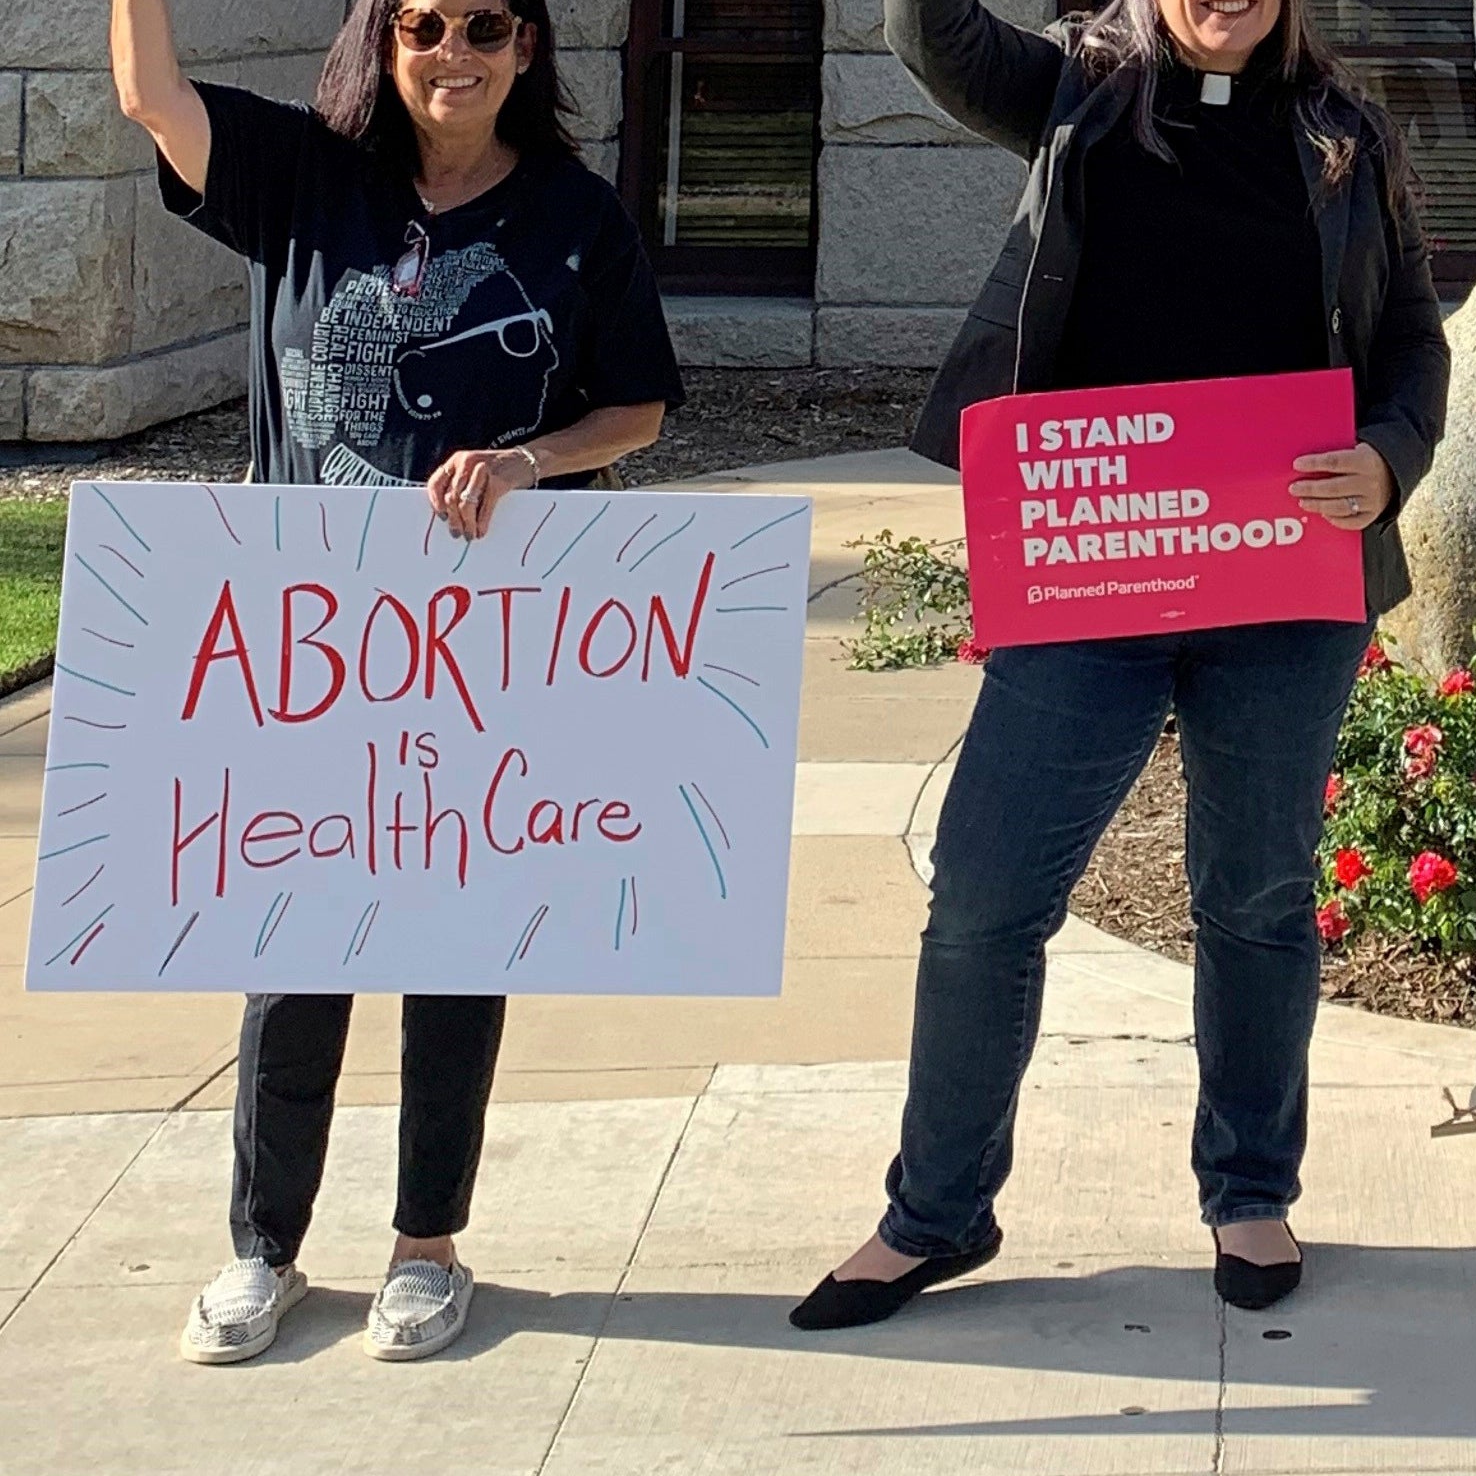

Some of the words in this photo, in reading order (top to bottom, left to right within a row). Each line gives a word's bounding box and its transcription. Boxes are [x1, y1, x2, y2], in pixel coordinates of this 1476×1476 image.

[320, 307, 341, 324] BE
[343, 310, 454, 332] INDEPENDENT
[311, 322, 331, 361] COURT
[350, 327, 409, 344] FEMINIST
[346, 342, 397, 364] FIGHT
[344, 363, 393, 377] DISSENT
[341, 392, 391, 410] FIGHT
[340, 409, 361, 421] FOR
[365, 410, 386, 423] THE
[345, 421, 384, 433] THINGS
[1016, 424, 1028, 452] I
[1040, 413, 1174, 449] STAND
[1019, 455, 1127, 490] WITH
[1021, 489, 1209, 529] PLANNED
[1023, 518, 1304, 566] PARENTHOOD
[1045, 582, 1105, 600] Planned
[1107, 576, 1196, 595] Parenthood
[182, 552, 714, 733] ABORTION
